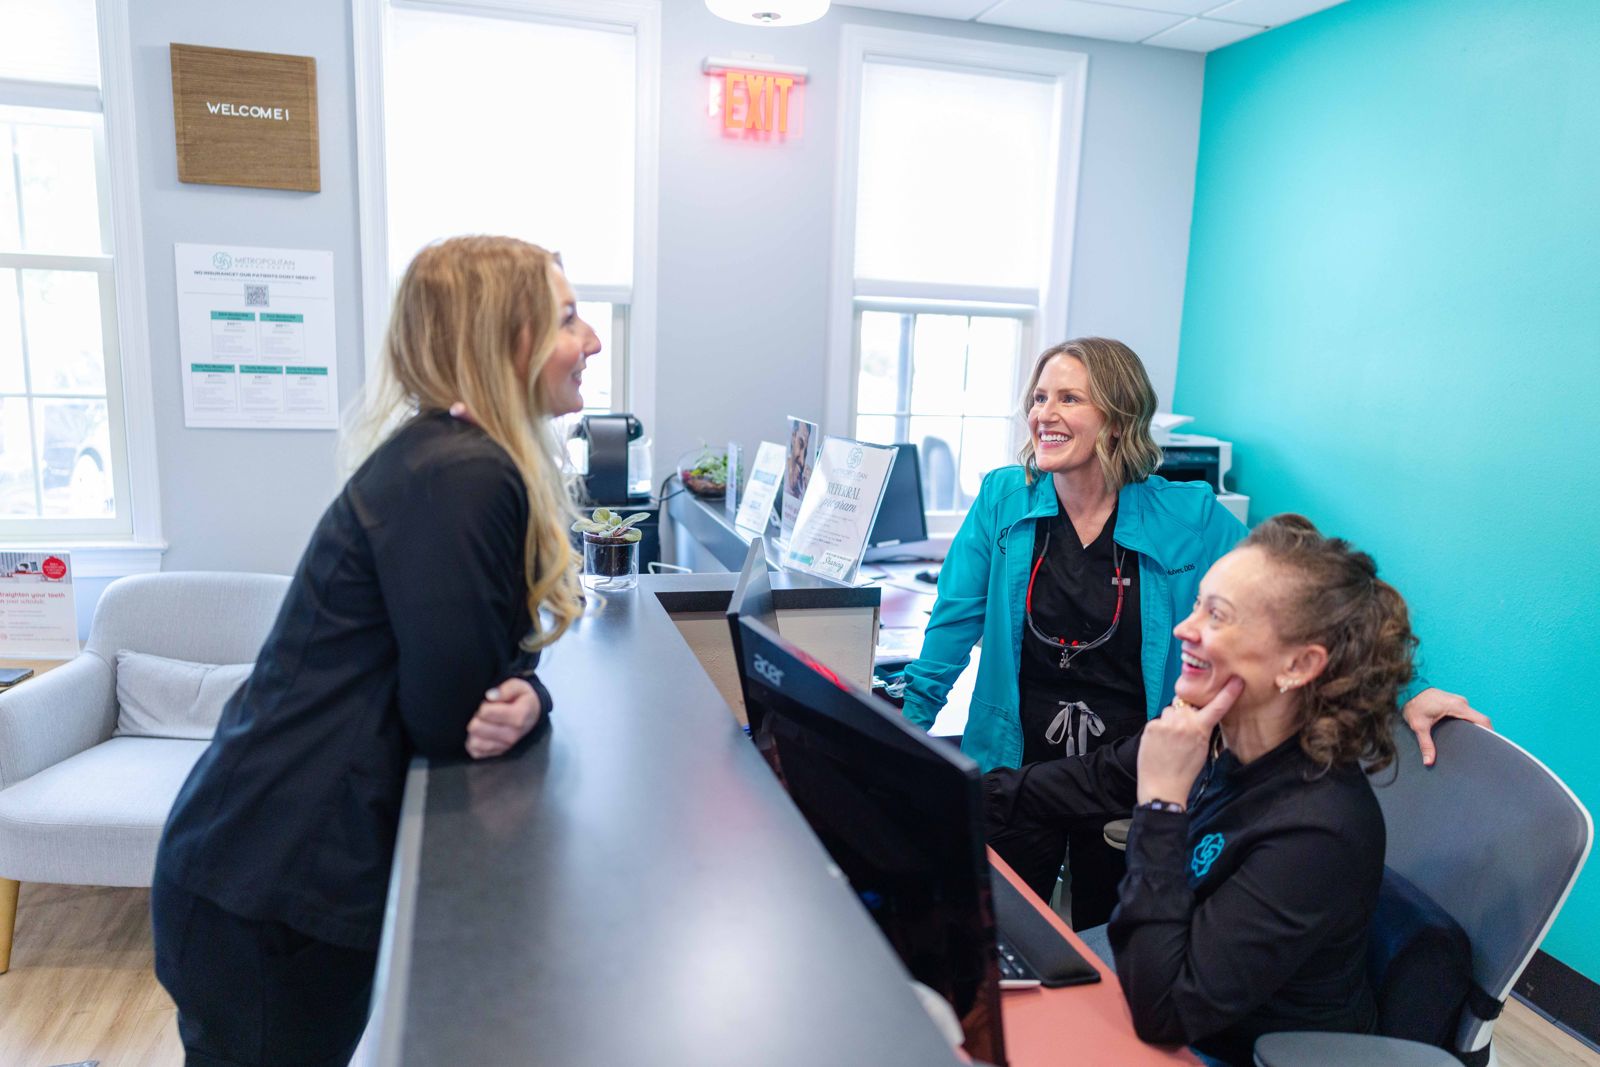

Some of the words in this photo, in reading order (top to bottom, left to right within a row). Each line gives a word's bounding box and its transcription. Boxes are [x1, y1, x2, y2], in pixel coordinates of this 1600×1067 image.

[725, 71, 794, 134] EXIT
[0, 591, 30, 599] traighten
[754, 653, 785, 687] acer
